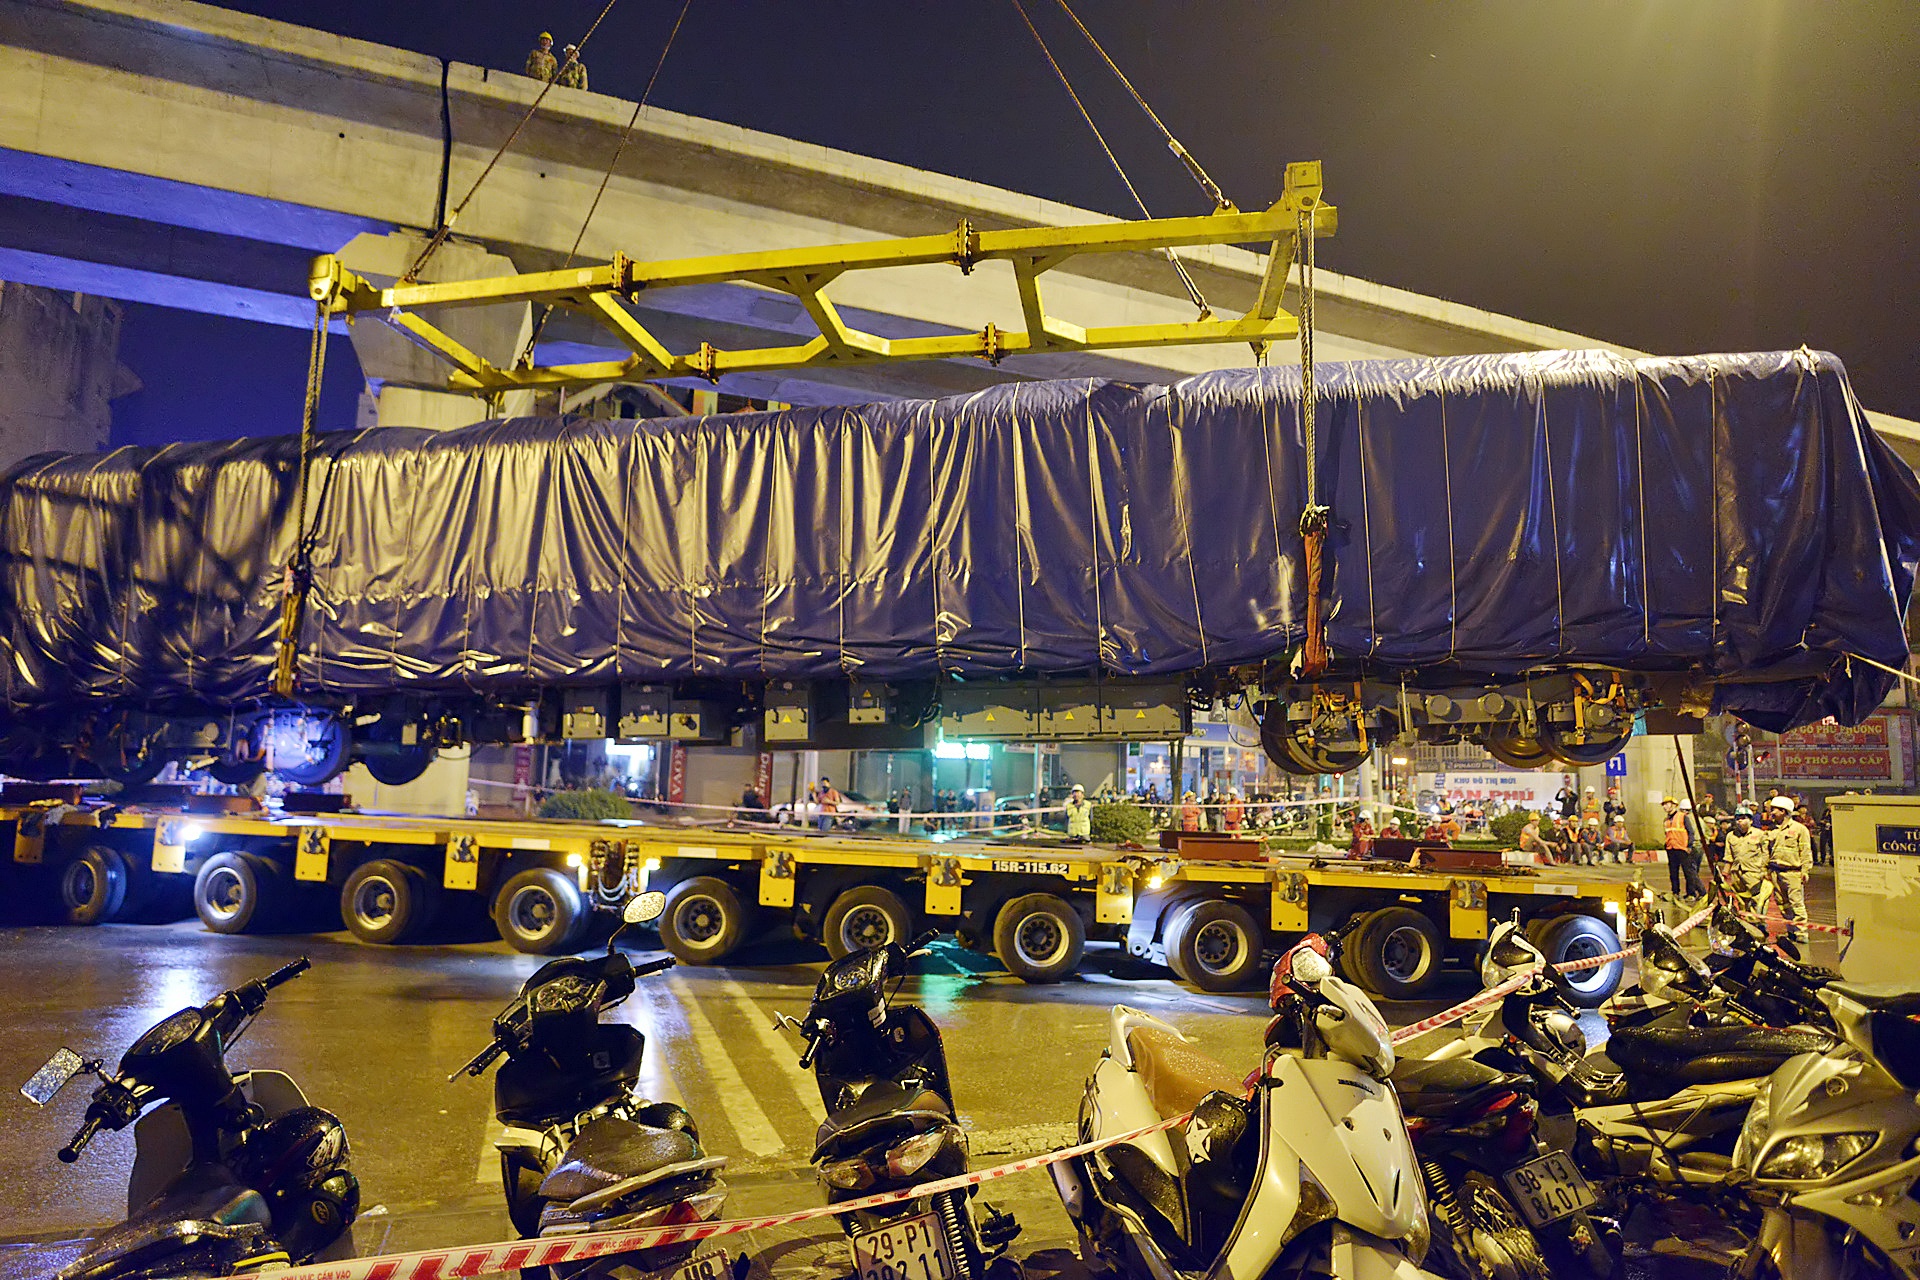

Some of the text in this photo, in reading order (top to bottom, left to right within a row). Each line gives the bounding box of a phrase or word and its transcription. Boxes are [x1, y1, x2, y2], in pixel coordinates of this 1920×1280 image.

[1882, 840, 1917, 852] CÔNG
[993, 861, 1067, 874] 15R-115.62
[1515, 1159, 1569, 1194] 98-Y3
[1532, 1182, 1583, 1220] 8407
[867, 1220, 931, 1265] 29-P1
